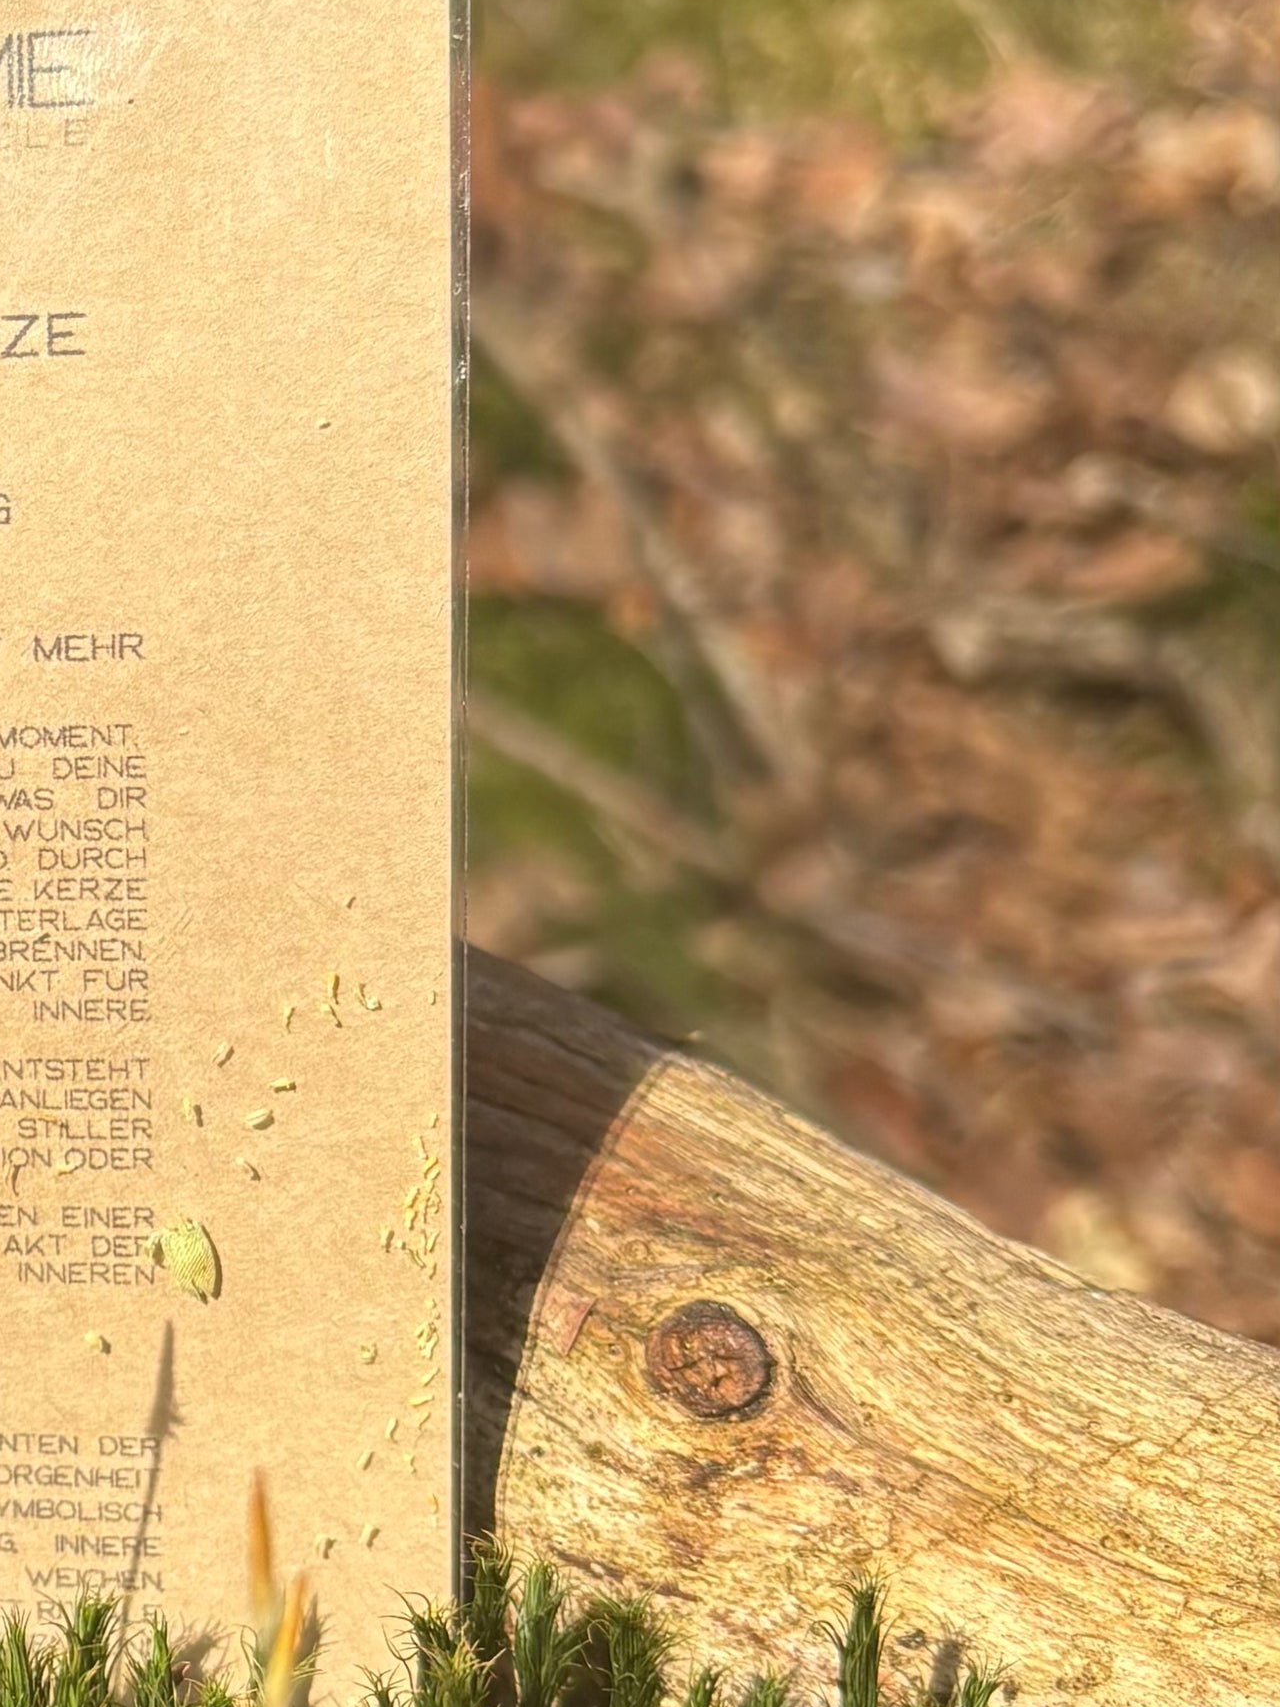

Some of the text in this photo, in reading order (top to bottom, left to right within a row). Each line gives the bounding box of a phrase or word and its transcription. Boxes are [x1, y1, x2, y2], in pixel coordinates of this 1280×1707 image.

[33, 634, 146, 662] MEHR
[53, 755, 146, 779] DEINE
[98, 786, 146, 810] DIR
[38, 847, 147, 871] DURCH
[34, 877, 148, 902] KERZE
[17, 1117, 153, 1140] STILLER
[63, 1147, 154, 1171] ODER
[62, 1205, 154, 1229] EINER
[4, 1233, 68, 1257] AKT
[17, 1262, 156, 1286] INNEREN
[98, 1435, 161, 1458] DER
[54, 1533, 163, 1558] INNERE
